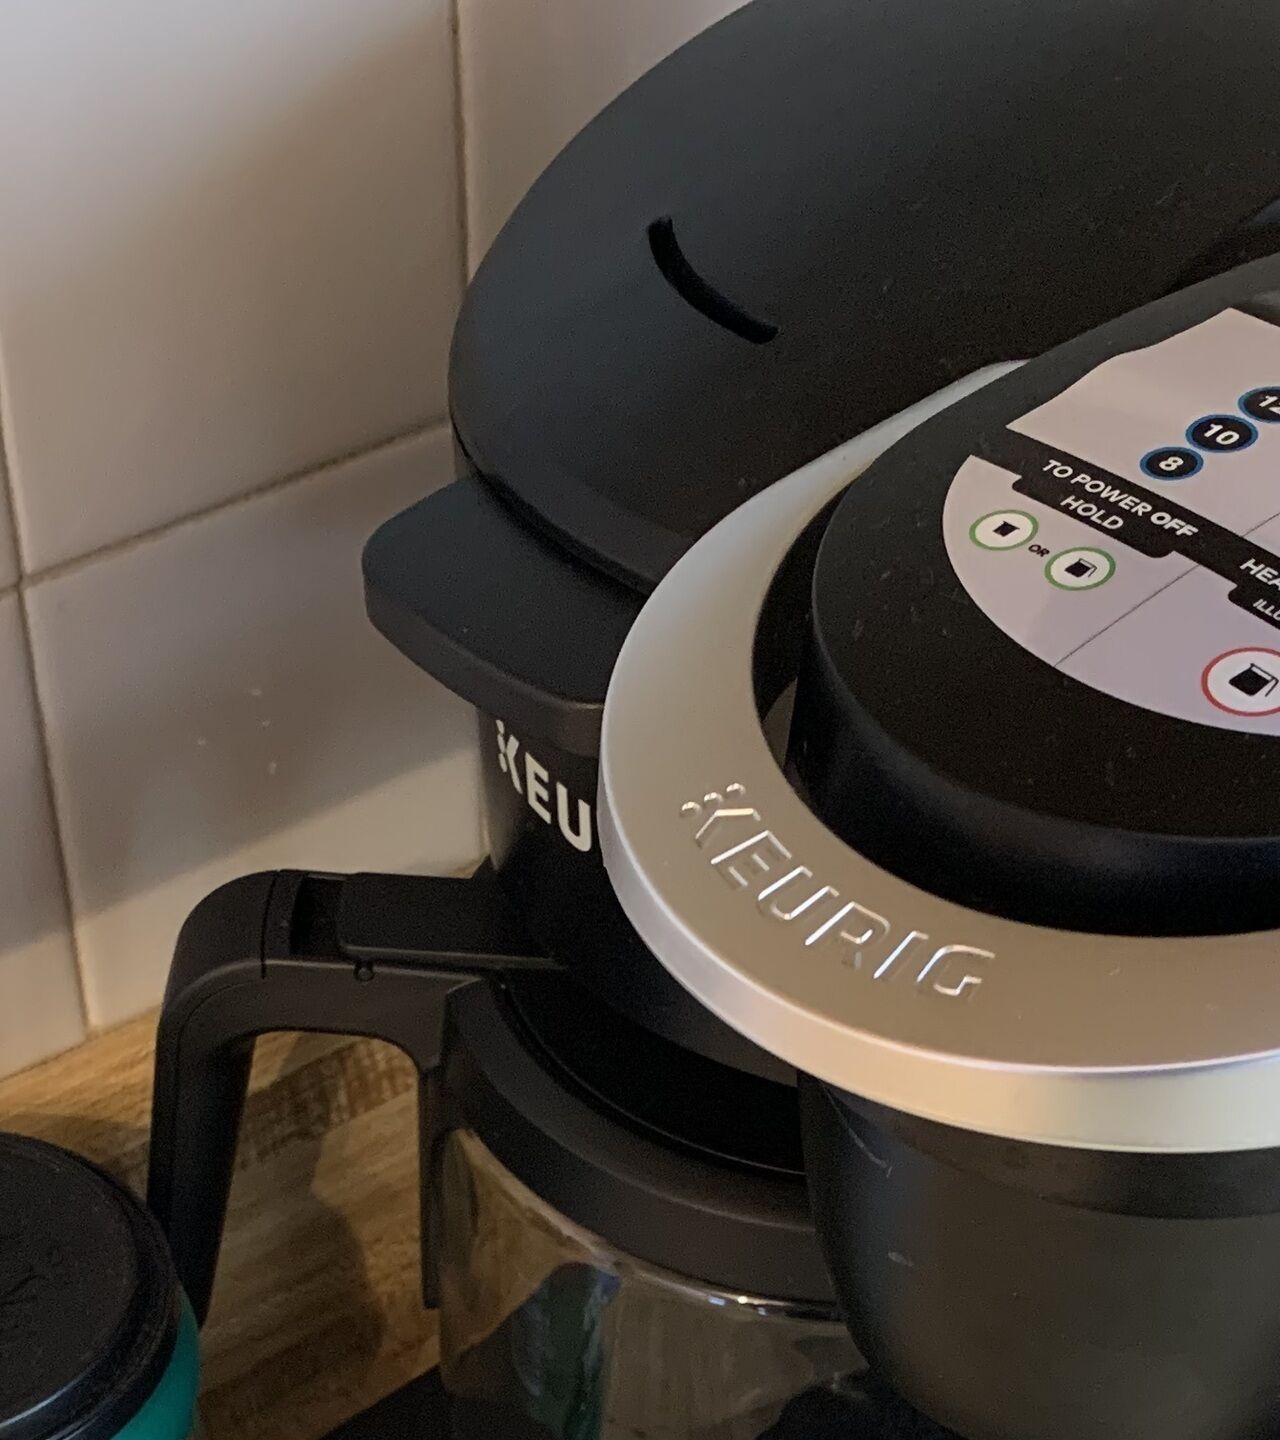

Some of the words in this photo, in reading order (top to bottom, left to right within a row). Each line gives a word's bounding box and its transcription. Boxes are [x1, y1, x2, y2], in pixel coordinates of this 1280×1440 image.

[1204, 424, 1240, 445] 10
[1159, 457, 1184, 471] 8
[1042, 460, 1072, 478] TO
[1071, 473, 1152, 517] POWER
[1150, 511, 1199, 539] OFF
[1061, 496, 1124, 531] HOLD
[1028, 544, 1050, 557] OR
[496, 720, 591, 853] KEU
[681, 783, 996, 998] KEURIG
